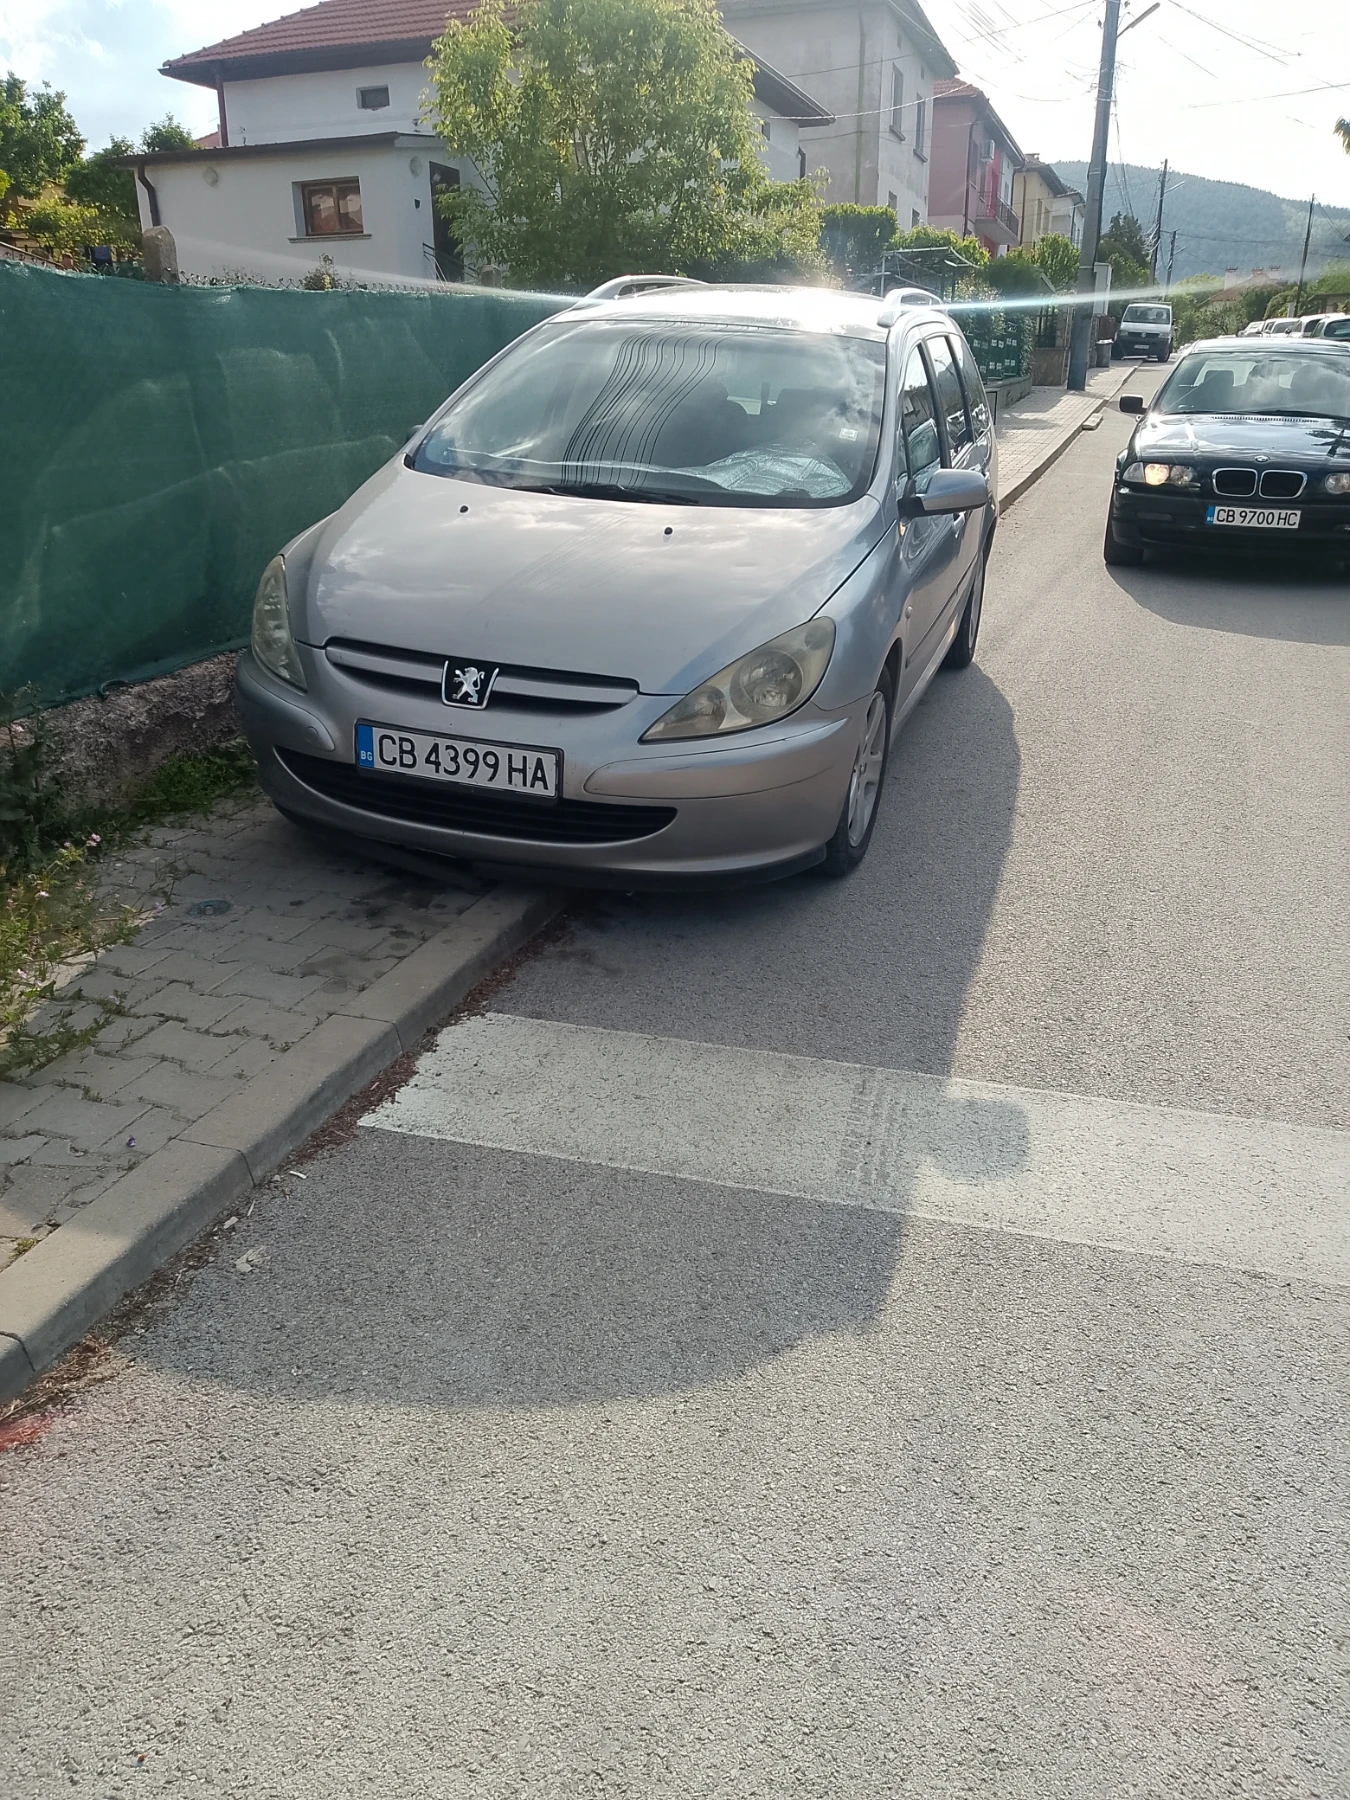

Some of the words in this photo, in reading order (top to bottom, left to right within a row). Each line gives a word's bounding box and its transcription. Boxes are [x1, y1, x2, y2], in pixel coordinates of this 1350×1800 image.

[1216, 508, 1236, 523] CB
[1239, 510, 1275, 525] 9700
[1277, 511, 1298, 526] HC
[360, 750, 373, 761] BG
[378, 734, 417, 768] CB
[424, 742, 500, 782] 4399
[507, 753, 549, 790] HA
